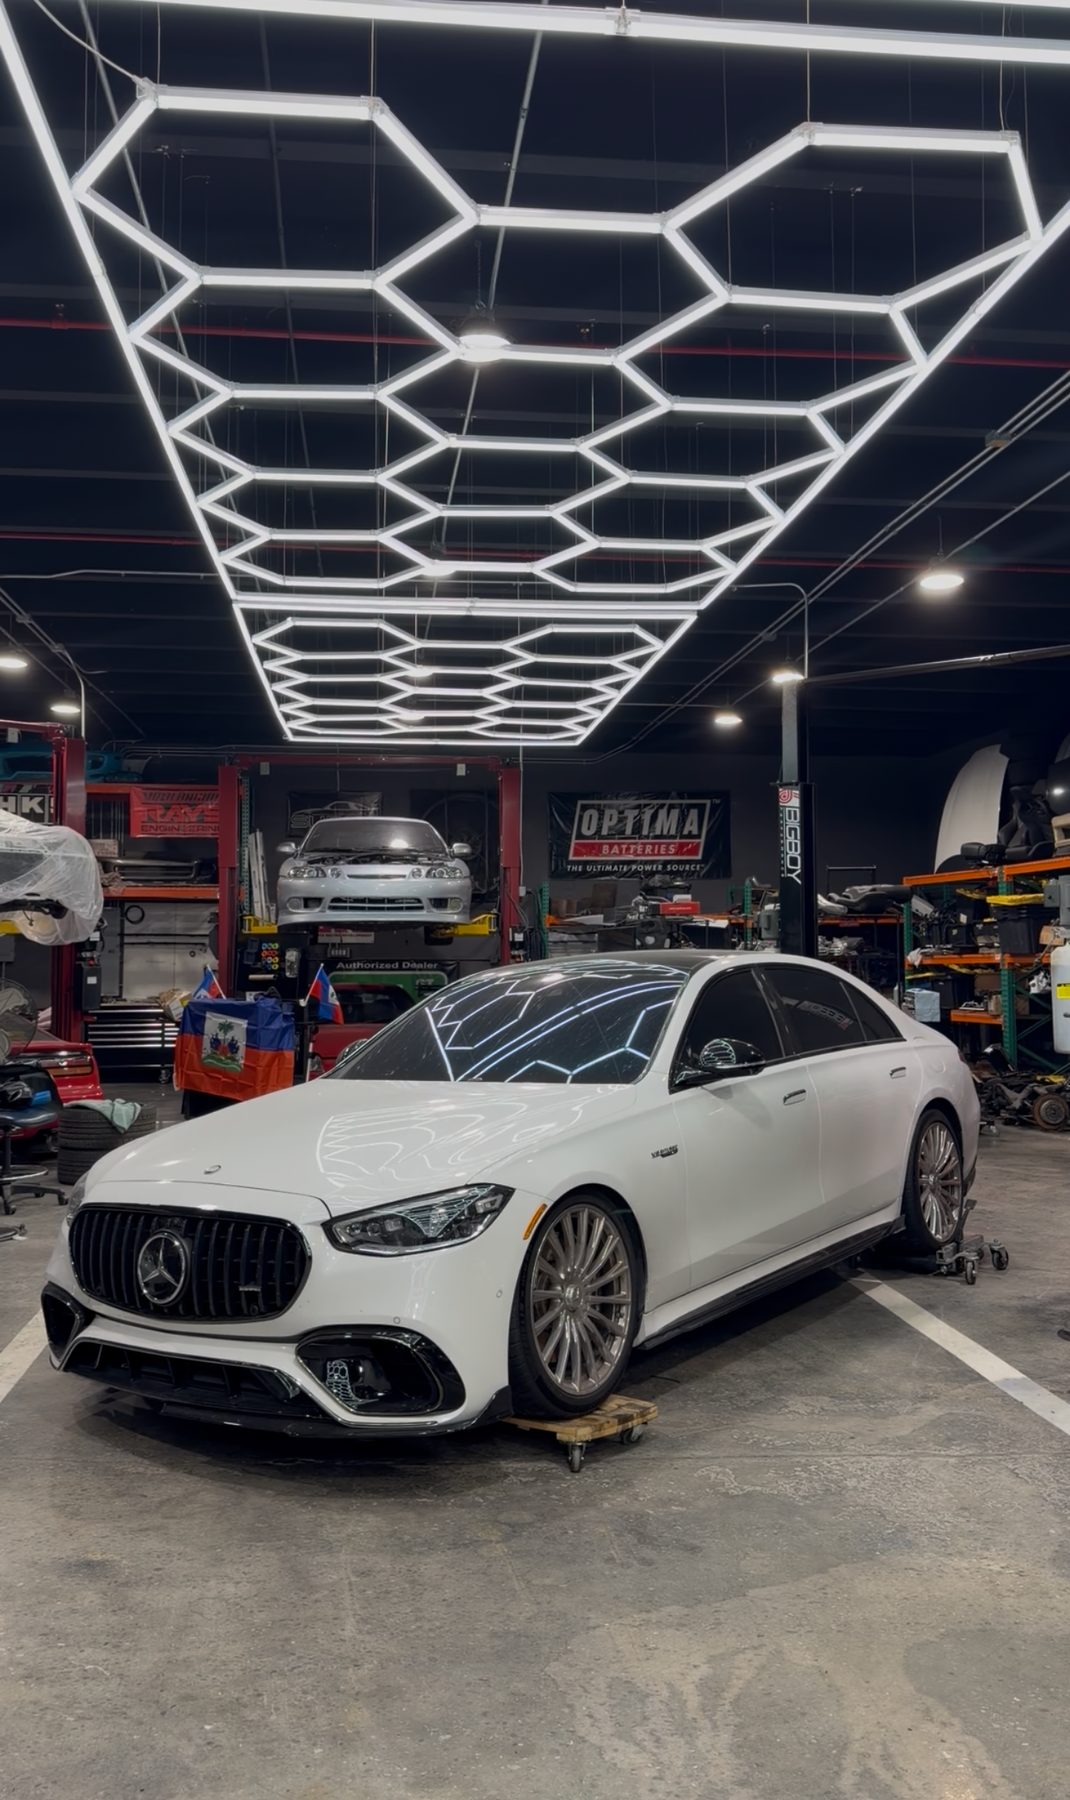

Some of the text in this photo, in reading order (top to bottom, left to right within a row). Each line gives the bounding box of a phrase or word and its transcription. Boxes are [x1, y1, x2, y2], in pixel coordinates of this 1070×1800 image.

[0, 796, 54, 814] HK
[581, 808, 699, 836] OPTIMA
[141, 824, 219, 833] ENGINEERIN
[602, 844, 676, 855] BATTERIES
[785, 807, 802, 885] BIGBOY
[586, 864, 628, 872] ULTIMATE
[631, 864, 663, 872] POWER
[667, 863, 700, 872] SOURCE
[336, 961, 439, 970] Authorized Dealer
